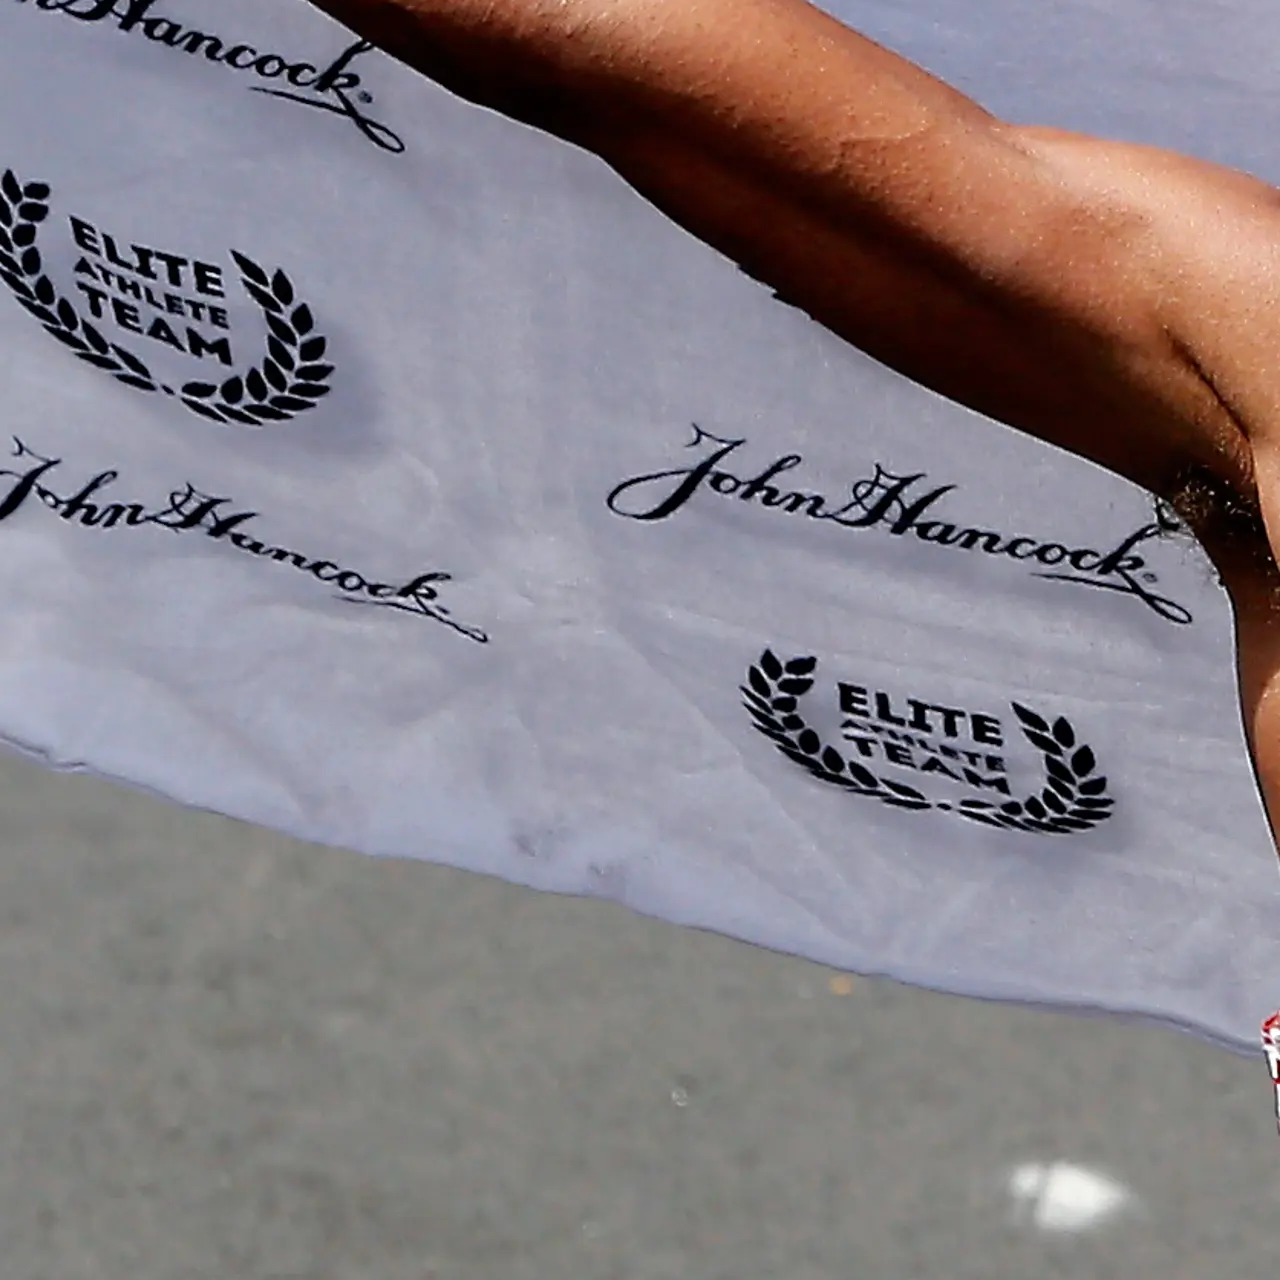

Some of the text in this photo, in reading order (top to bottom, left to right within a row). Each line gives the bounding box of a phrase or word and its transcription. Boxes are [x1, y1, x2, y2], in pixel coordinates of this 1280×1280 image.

[68, 215, 226, 299] ELITE
[73, 256, 230, 331] ATHLETE
[76, 281, 234, 367] TEAM
[0, 435, 489, 643] John Hancock
[607, 422, 1192, 624] John Hancock
[837, 682, 1004, 748] ELITE
[842, 733, 1012, 797] TEAM
